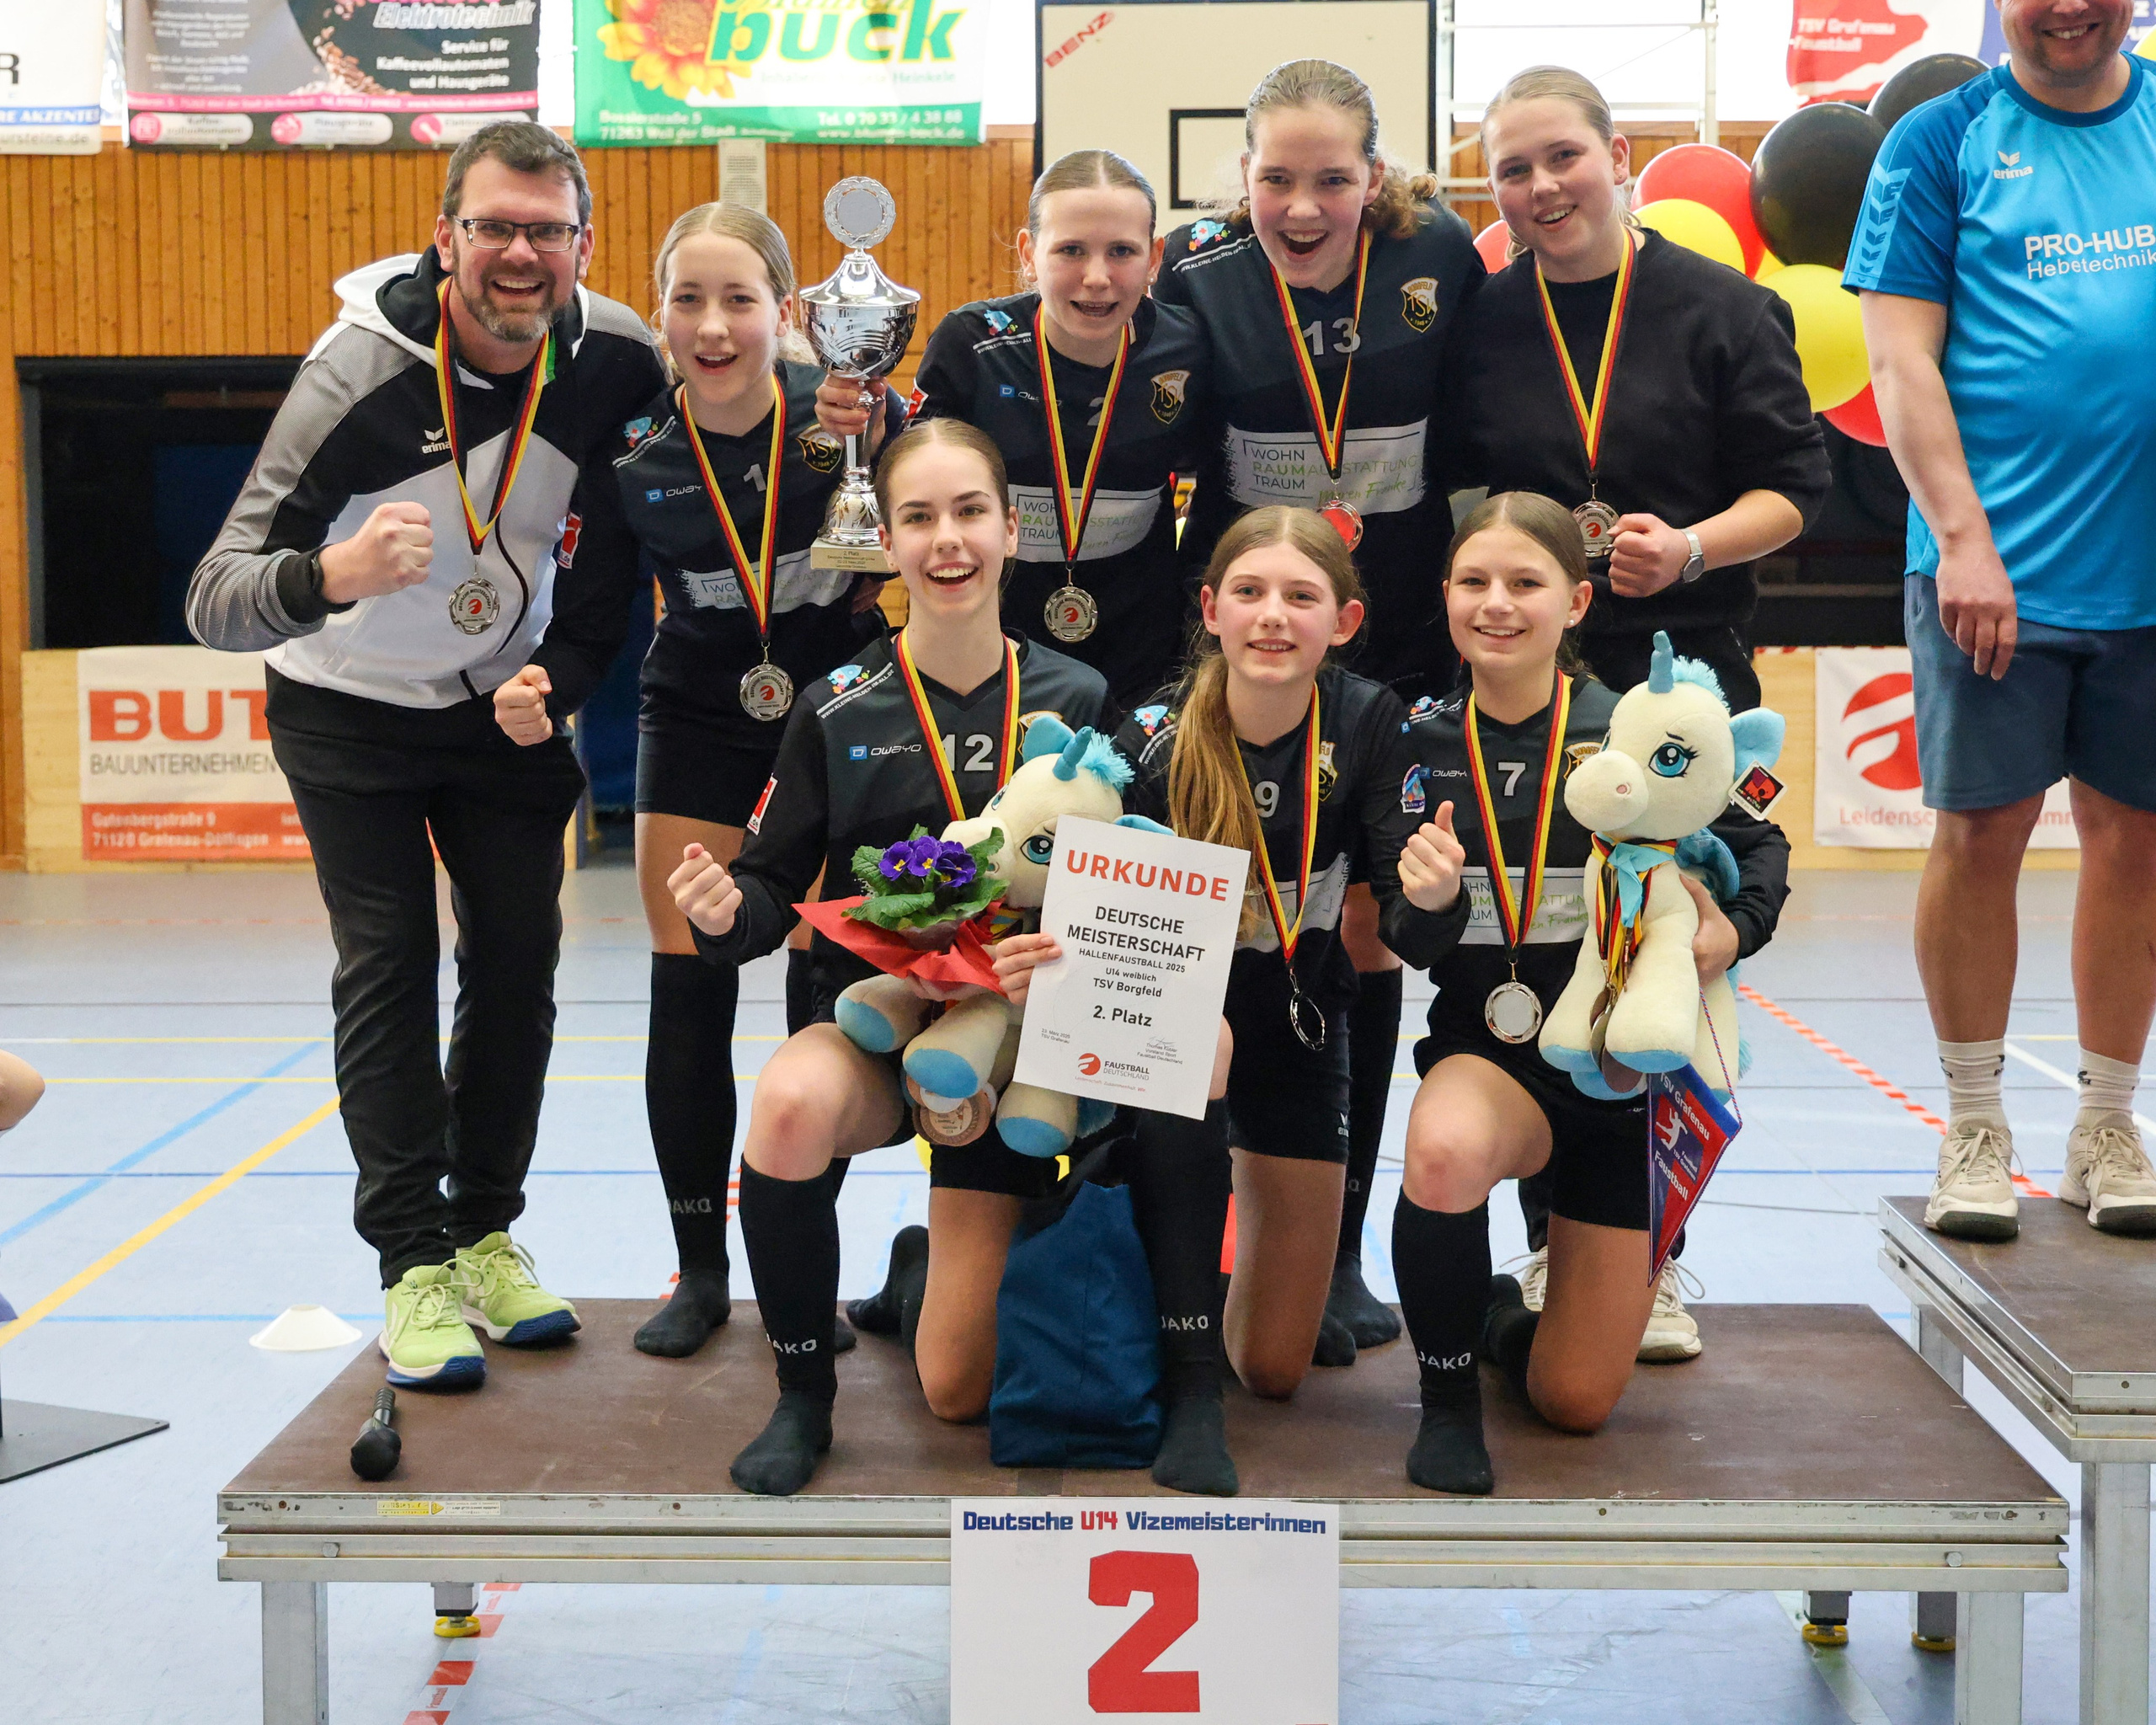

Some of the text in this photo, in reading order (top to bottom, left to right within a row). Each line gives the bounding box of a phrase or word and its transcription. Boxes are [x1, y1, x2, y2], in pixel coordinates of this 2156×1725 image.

[373, 0, 537, 29] Elektrotechnik
[1797, 18, 1827, 34] TSV
[441, 40, 488, 54] Service
[1044, 11, 1116, 68] BENZ
[1993, 165, 2034, 180] erima
[2024, 224, 2156, 261] PRO-HUB
[2026, 248, 2156, 280] Hebetechnik
[1302, 317, 1362, 356] 13
[1087, 396, 1105, 426] 2
[421, 441, 452, 455] erima
[1251, 449, 1305, 462] WOHN
[743, 463, 767, 493] 1
[1252, 474, 1305, 490] TRAUM
[89, 752, 278, 776] BAUUNTERNEHMEN
[942, 733, 994, 772] 12
[1497, 761, 1527, 797] 7
[1254, 780, 1280, 819] 9
[1066, 849, 1230, 901] URKUNDE
[1095, 905, 1185, 934] DEUTSCHE
[1067, 924, 1206, 961] MEISTERSCHAFT
[1079, 948, 1186, 973] HALLENFAUSTBALL 2025
[1093, 978, 1162, 998] TSV Borgfeld
[1105, 967, 1157, 982] U14 weiblich
[1092, 1005, 1153, 1028] 2. Platz
[1103, 1067, 1150, 1081] DEUTSCHLAND
[1104, 1060, 1150, 1075] FAUSTBALL
[1674, 1090, 1710, 1141] Grafenau
[1654, 1149, 1689, 1201] Faustball
[1161, 1314, 1209, 1331] JAKO
[1417, 1350, 1471, 1370] JAKO
[963, 1510, 1326, 1535] Deutsche U14 Vizemeisterinnen
[1087, 1549, 1201, 1713] 2
